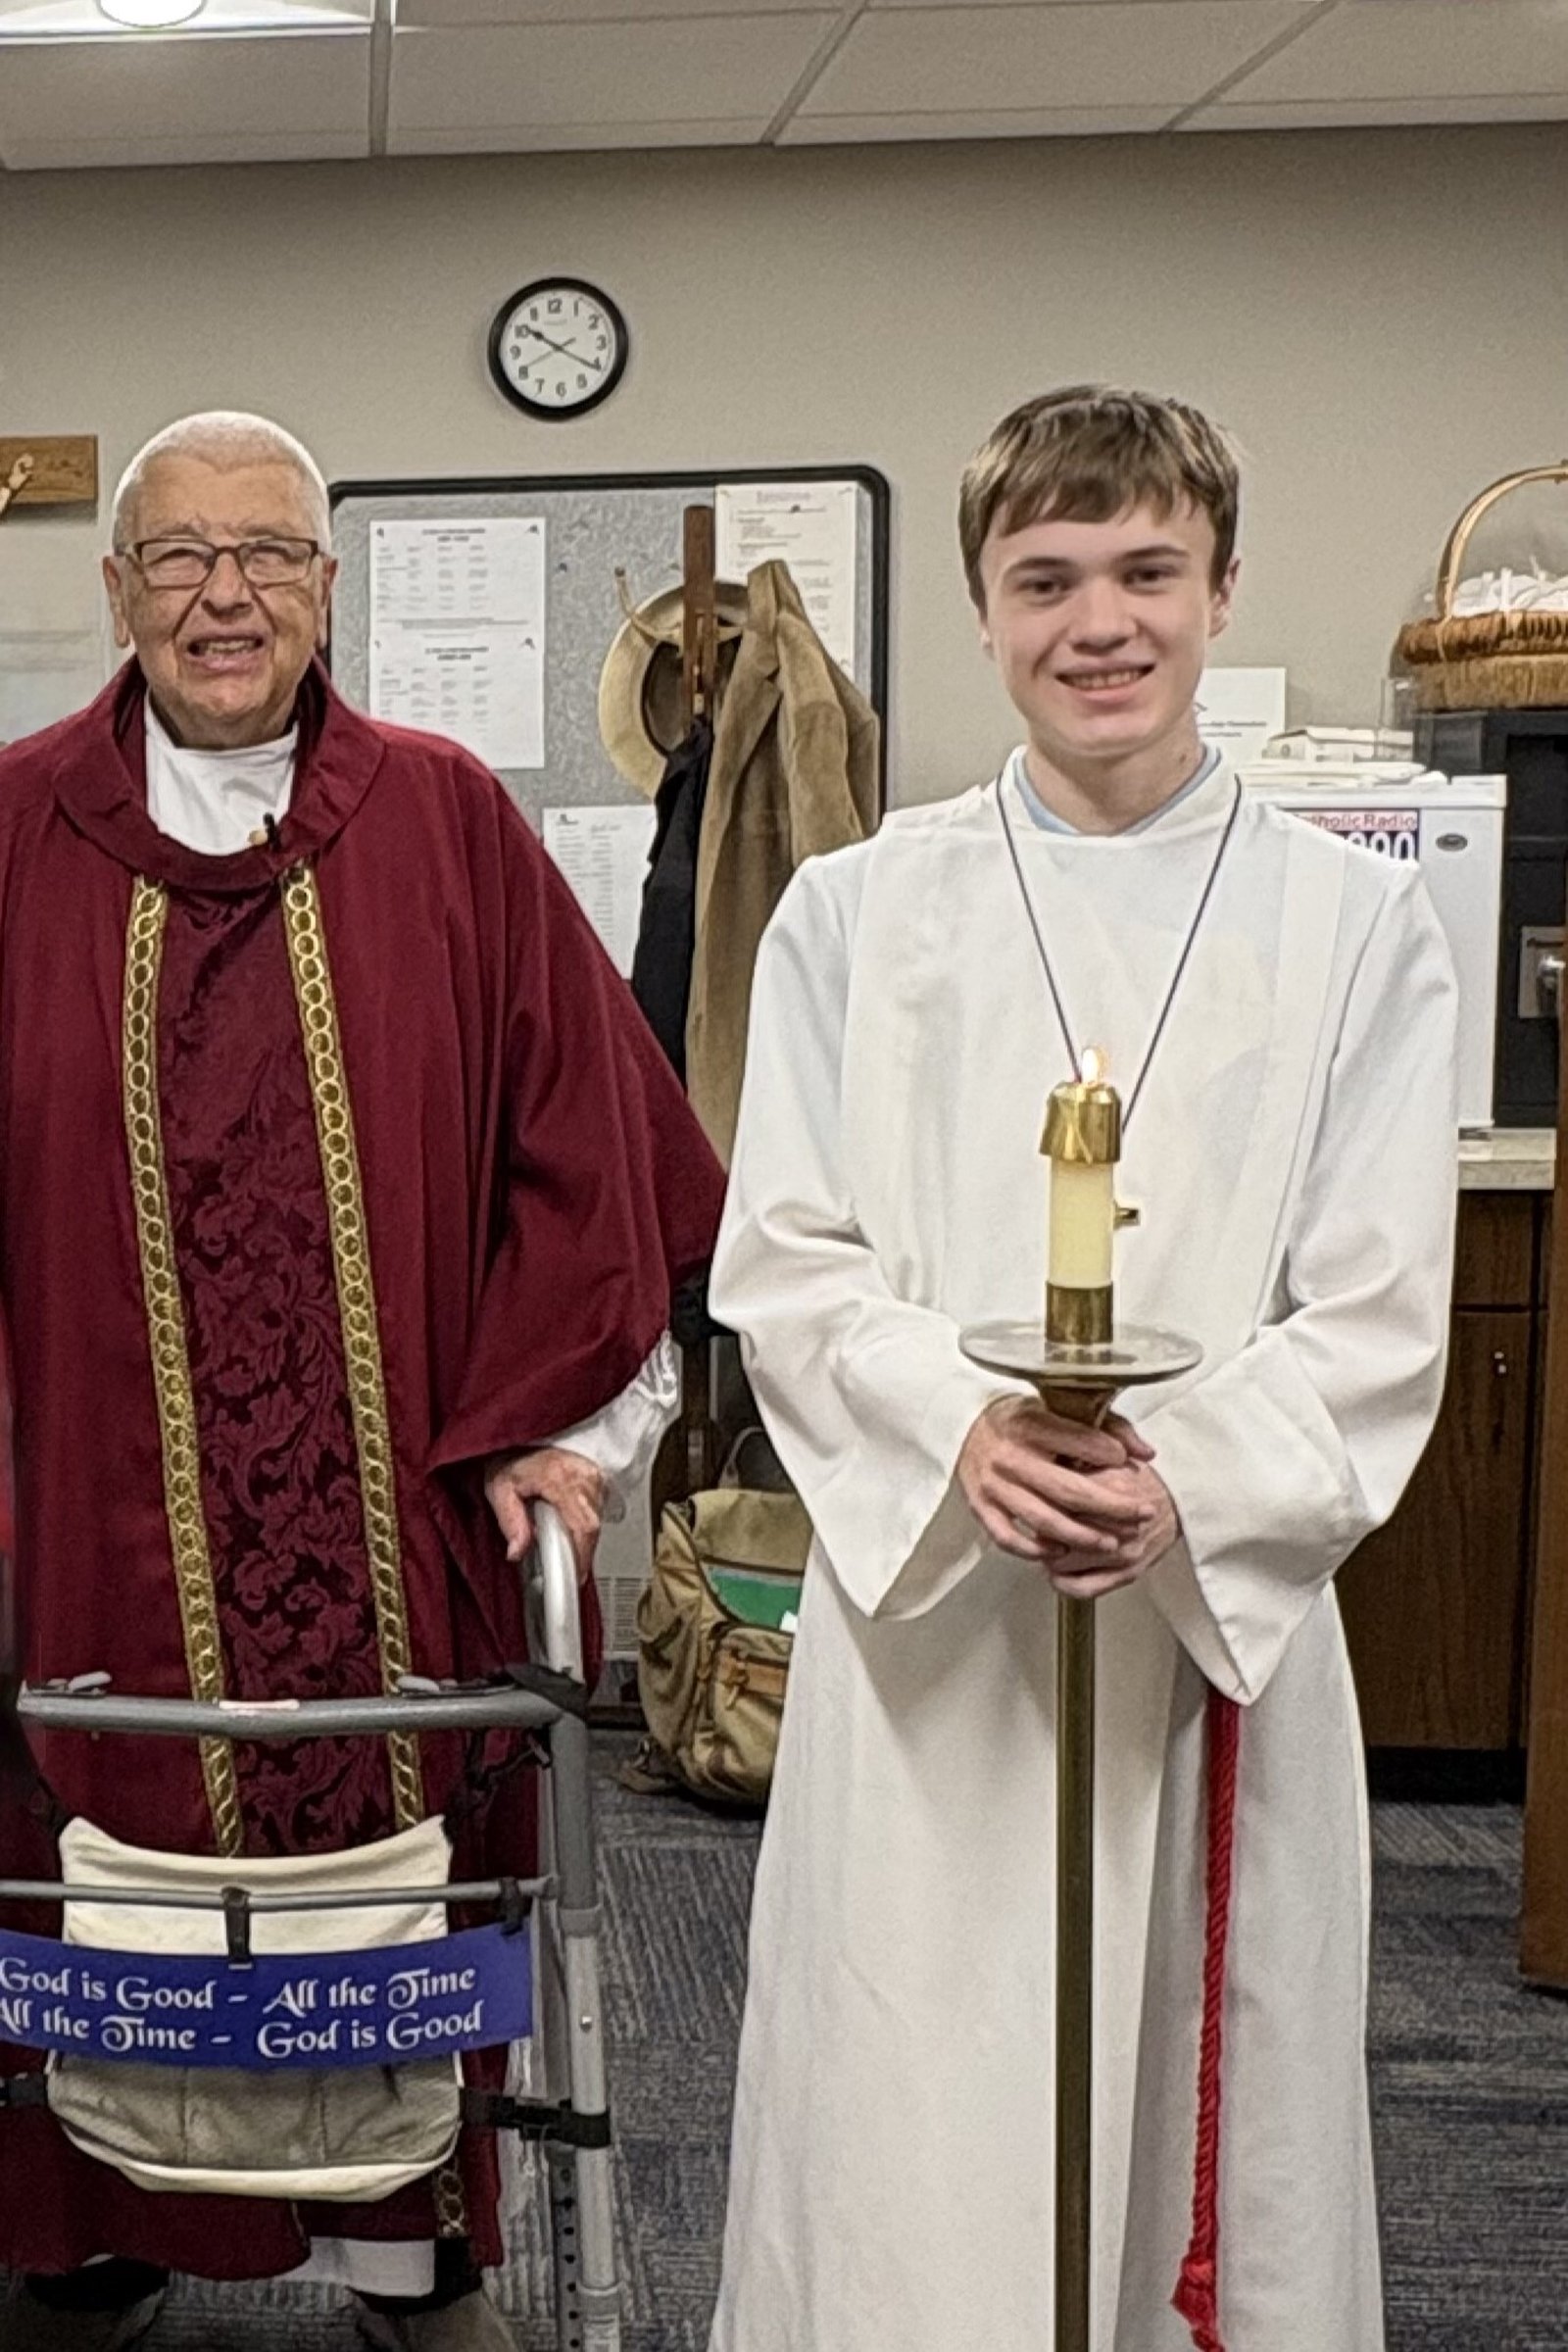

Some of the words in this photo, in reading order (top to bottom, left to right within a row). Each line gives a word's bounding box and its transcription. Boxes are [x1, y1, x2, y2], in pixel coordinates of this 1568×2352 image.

[548, 298, 563, 314] 12
[573, 301, 579, 317] 1
[588, 315, 599, 330] 2
[596, 334, 607, 351] 3
[510, 345, 521, 360] 9
[535, 378, 545, 394] 7
[556, 382, 567, 397] 6
[1364, 813, 1415, 829] Radio
[0, 1957, 71, 1996] God
[81, 1972, 107, 2001] is
[117, 1976, 217, 2010] Good
[263, 1979, 318, 2018] All
[329, 1977, 377, 2008] the
[386, 1967, 476, 2010] Time
[42, 2006, 90, 2039] the
[100, 2015, 196, 2052] Time
[257, 2019, 341, 2059] God
[351, 2019, 376, 2048] is
[386, 1999, 485, 2050] Good
